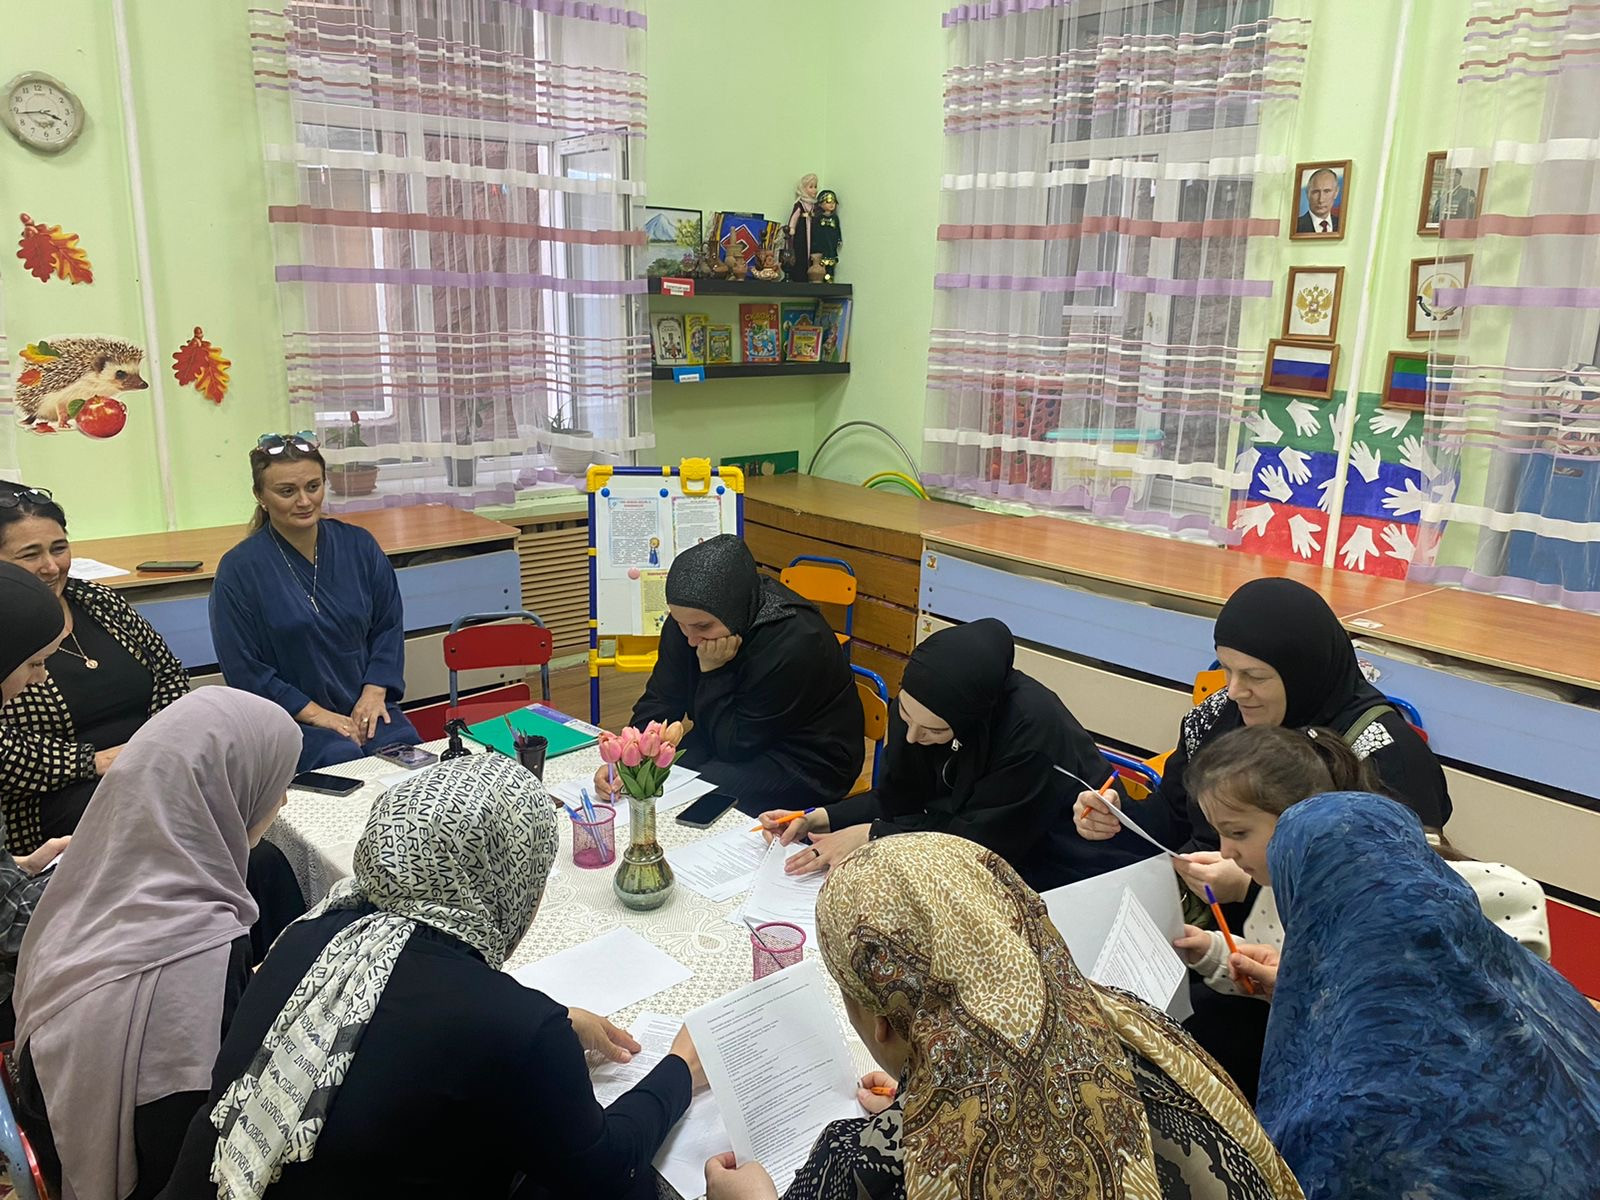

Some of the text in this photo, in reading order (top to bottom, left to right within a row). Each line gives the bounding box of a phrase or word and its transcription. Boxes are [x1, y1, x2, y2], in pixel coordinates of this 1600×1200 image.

[440, 773, 476, 838] ARMANI
[261, 1096, 285, 1126] ARMANI
[225, 1141, 250, 1173] ARMANI
[246, 1123, 271, 1159] EMPORIO
